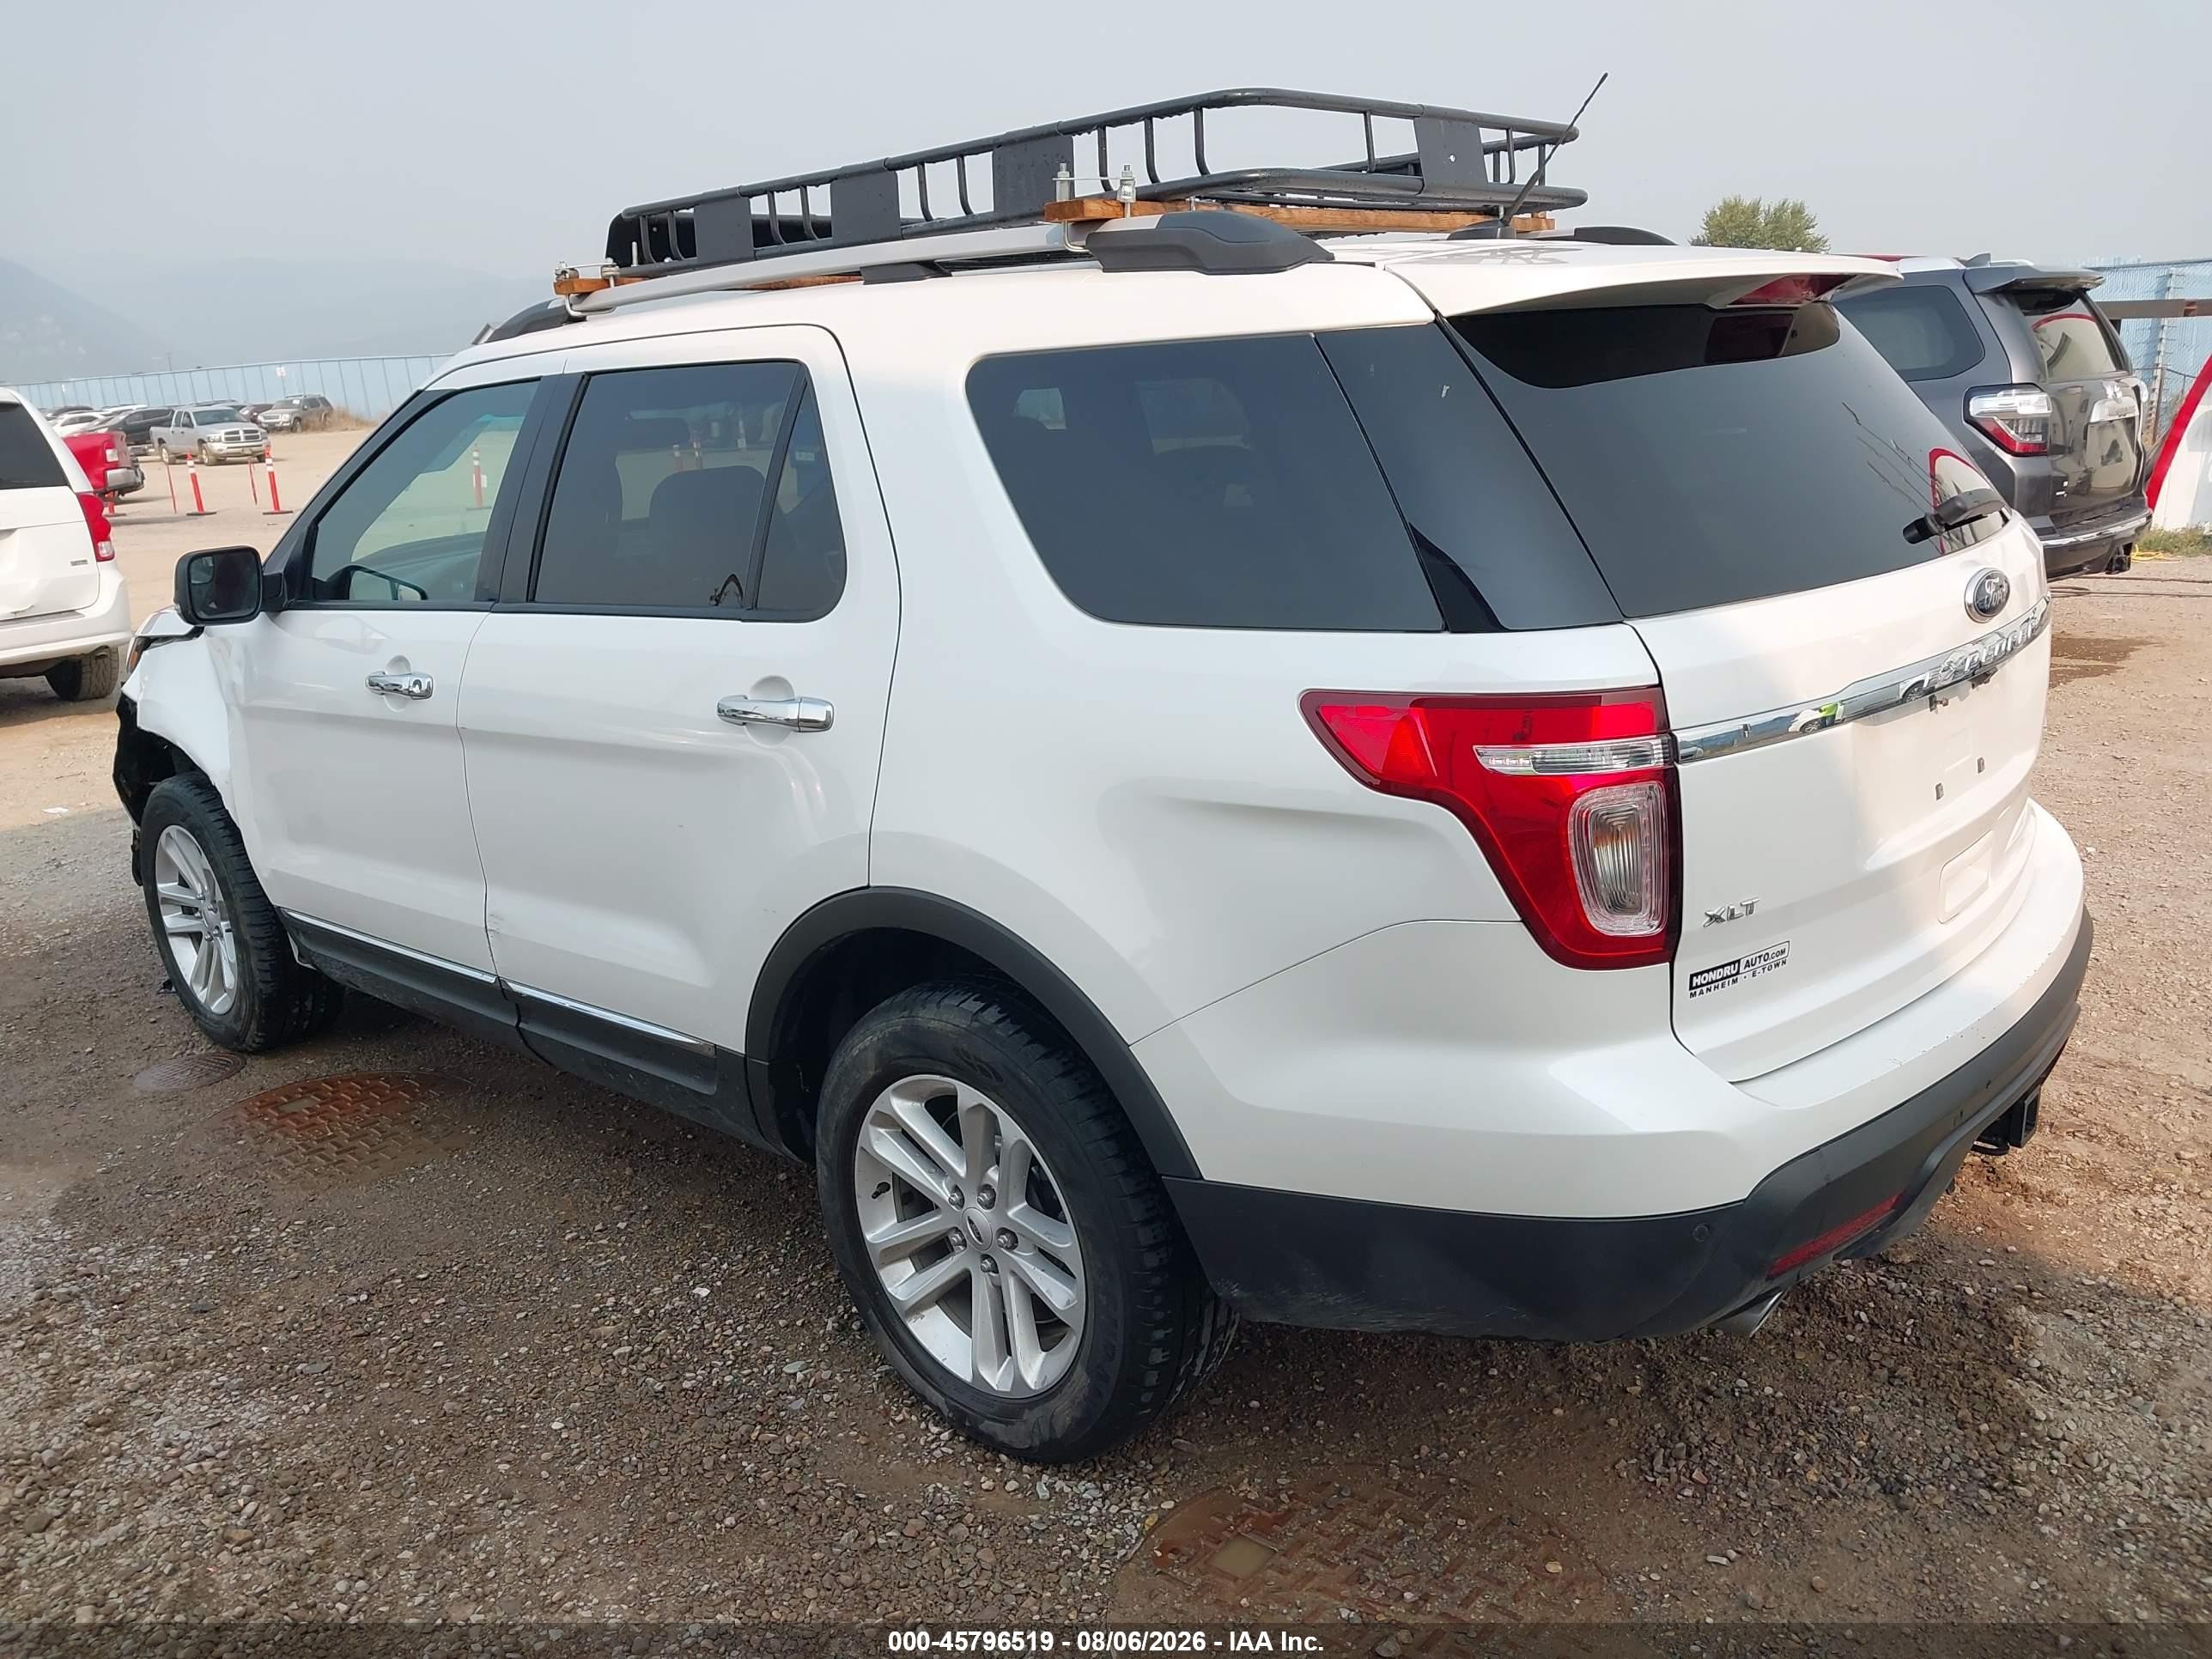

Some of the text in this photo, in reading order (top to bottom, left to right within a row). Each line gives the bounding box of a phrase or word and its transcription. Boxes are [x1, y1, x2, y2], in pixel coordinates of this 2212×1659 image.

[1977, 576, 2008, 611] Ford
[1703, 897, 1760, 927] XLT
[1689, 977, 1739, 999] MANHEIM
[1752, 958, 1787, 978] E-TOWN
[1692, 963, 1739, 988] HONDRU
